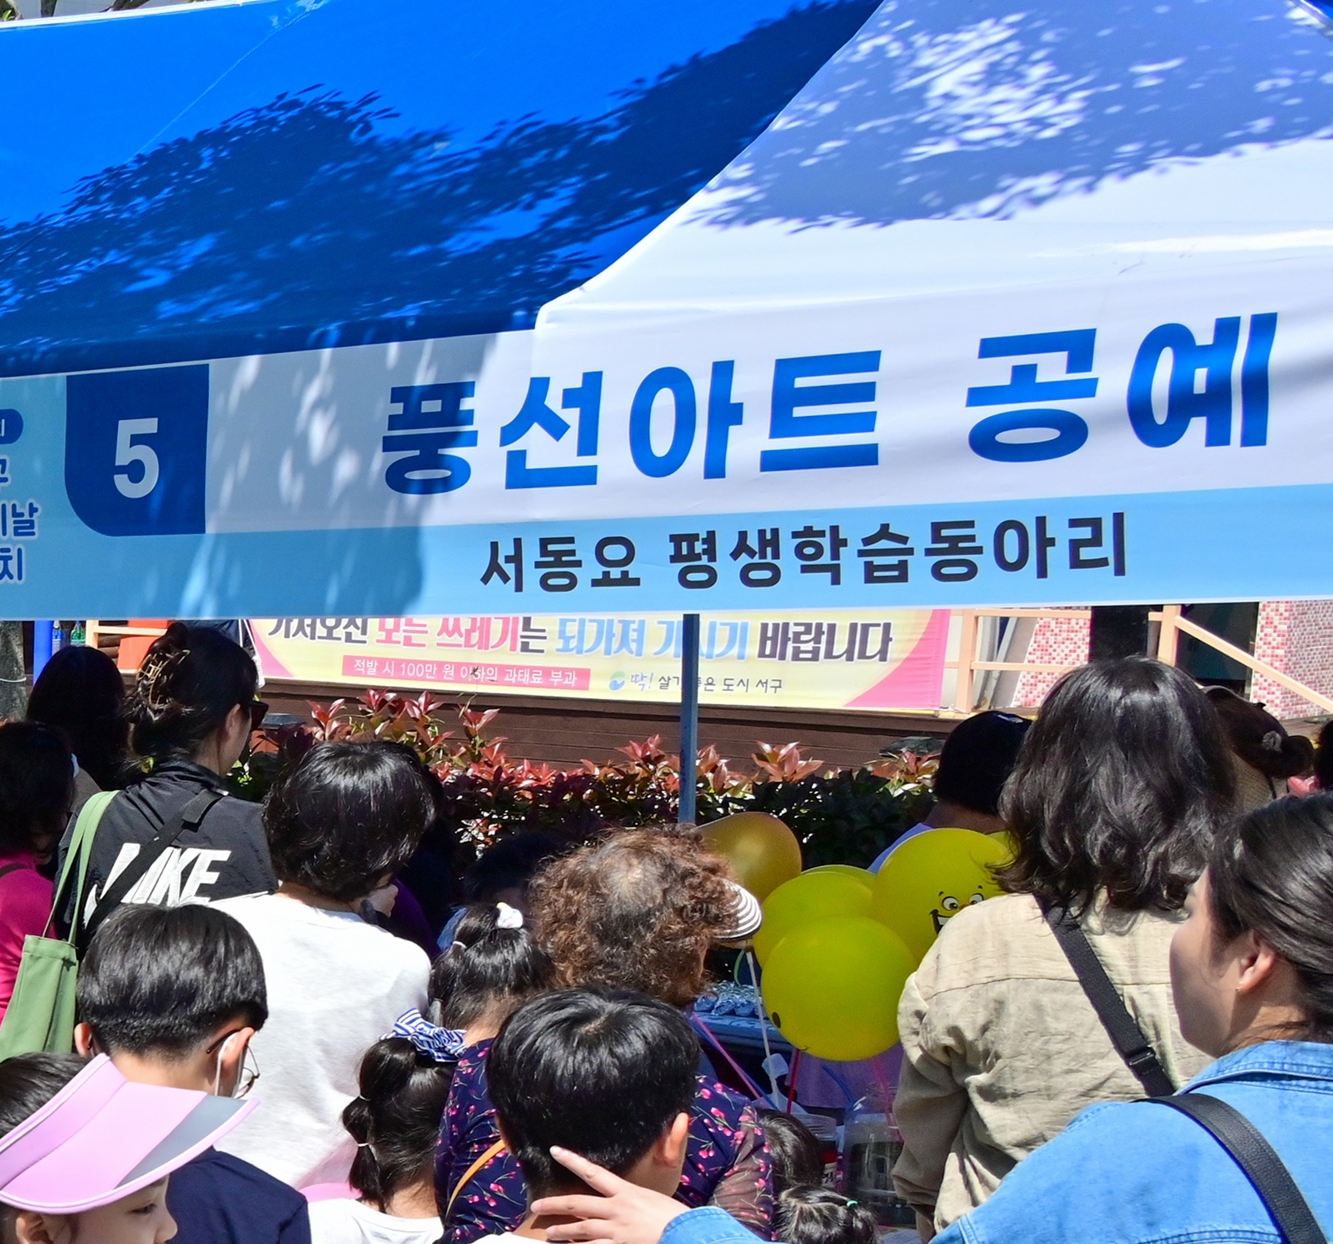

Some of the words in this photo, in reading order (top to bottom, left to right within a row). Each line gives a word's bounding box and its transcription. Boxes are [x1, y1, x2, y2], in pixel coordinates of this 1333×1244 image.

[381, 348, 882, 496] 풍선아트
[966, 311, 1280, 463] 공예
[113, 417, 161, 499] 5
[480, 533, 642, 594] 서동요
[667, 510, 1128, 592] 평생학습동아리
[376, 617, 430, 647] 모든
[436, 616, 547, 653] 쓰레기는
[557, 618, 645, 657] 되가져
[757, 622, 892, 663] 바랍니다
[354, 659, 378, 677] 적발
[382, 661, 394, 677] 시
[400, 662, 438, 679] 100만
[442, 664, 454, 680] 원
[503, 668, 543, 685] 과태료
[550, 670, 577, 687] 부과
[722, 677, 749, 692] 도시
[756, 678, 782, 694] 서구
